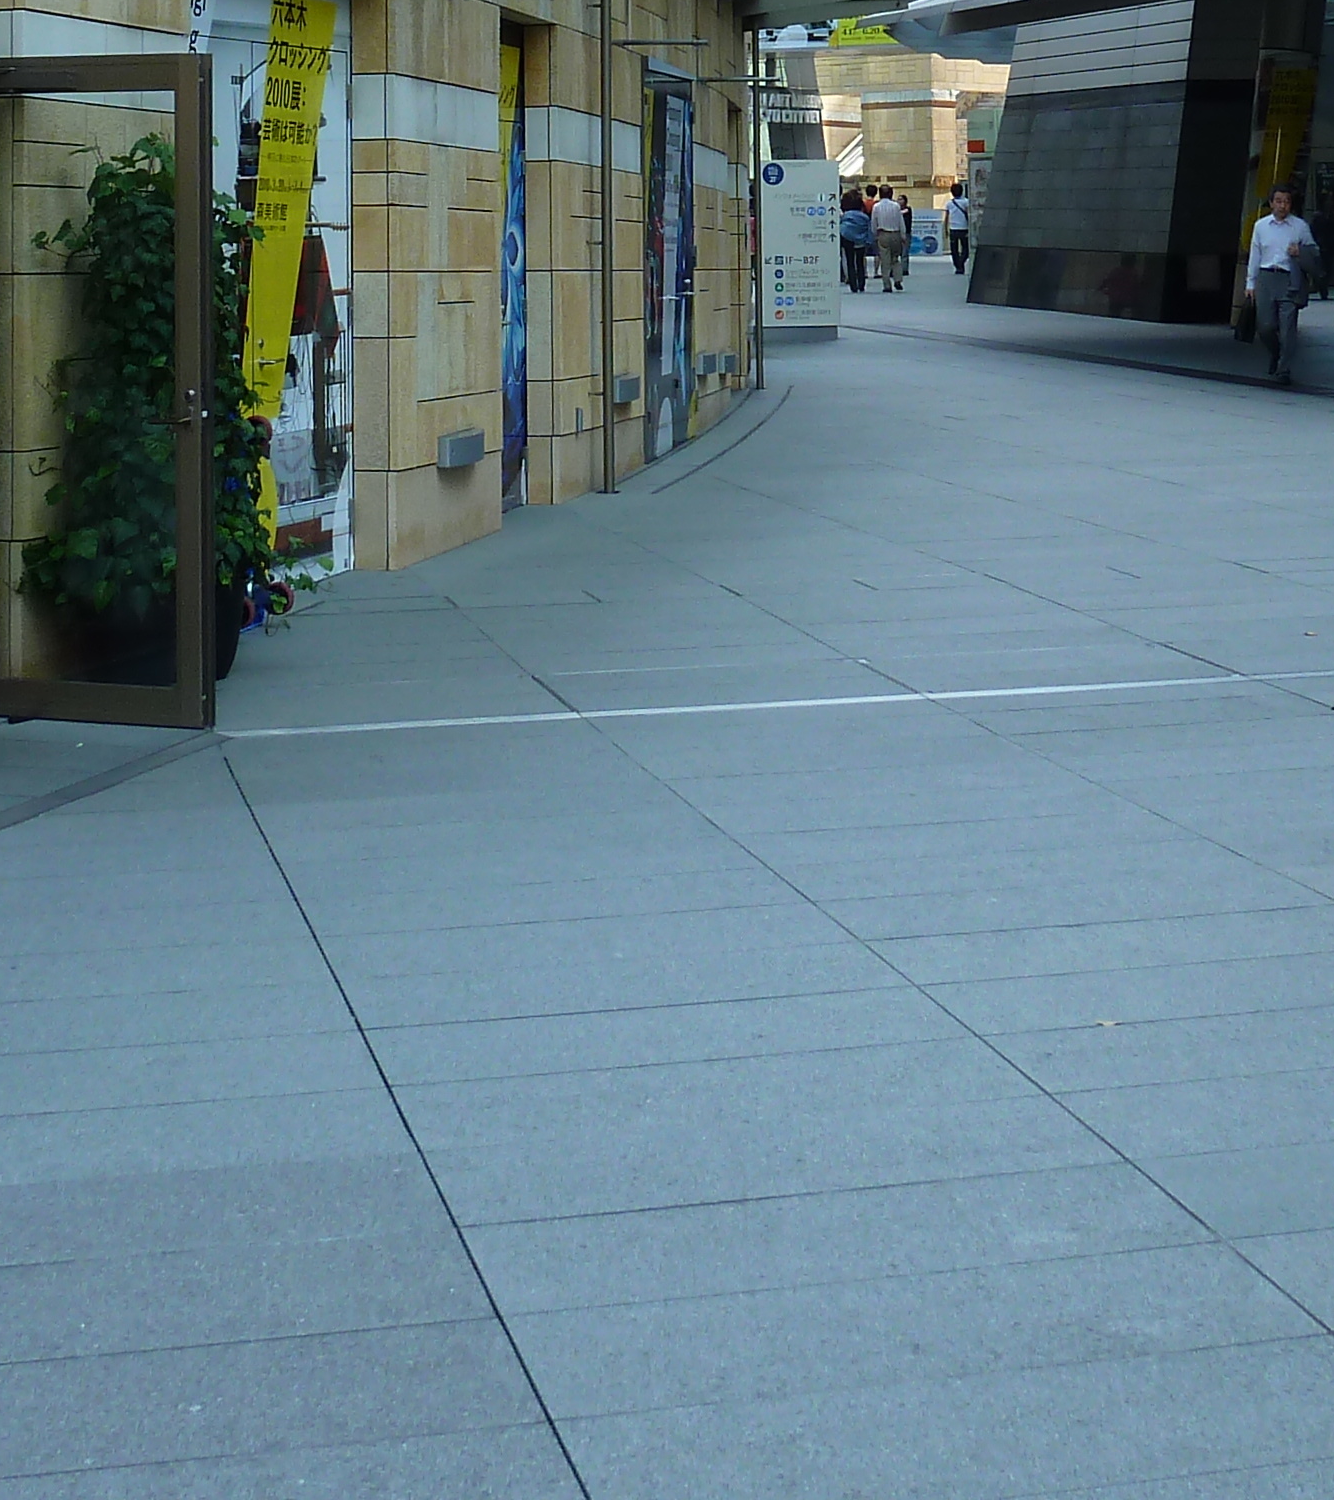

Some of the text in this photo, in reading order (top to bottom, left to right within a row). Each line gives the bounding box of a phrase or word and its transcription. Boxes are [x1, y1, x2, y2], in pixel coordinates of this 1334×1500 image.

[269, 36, 330, 74] クロッシング
